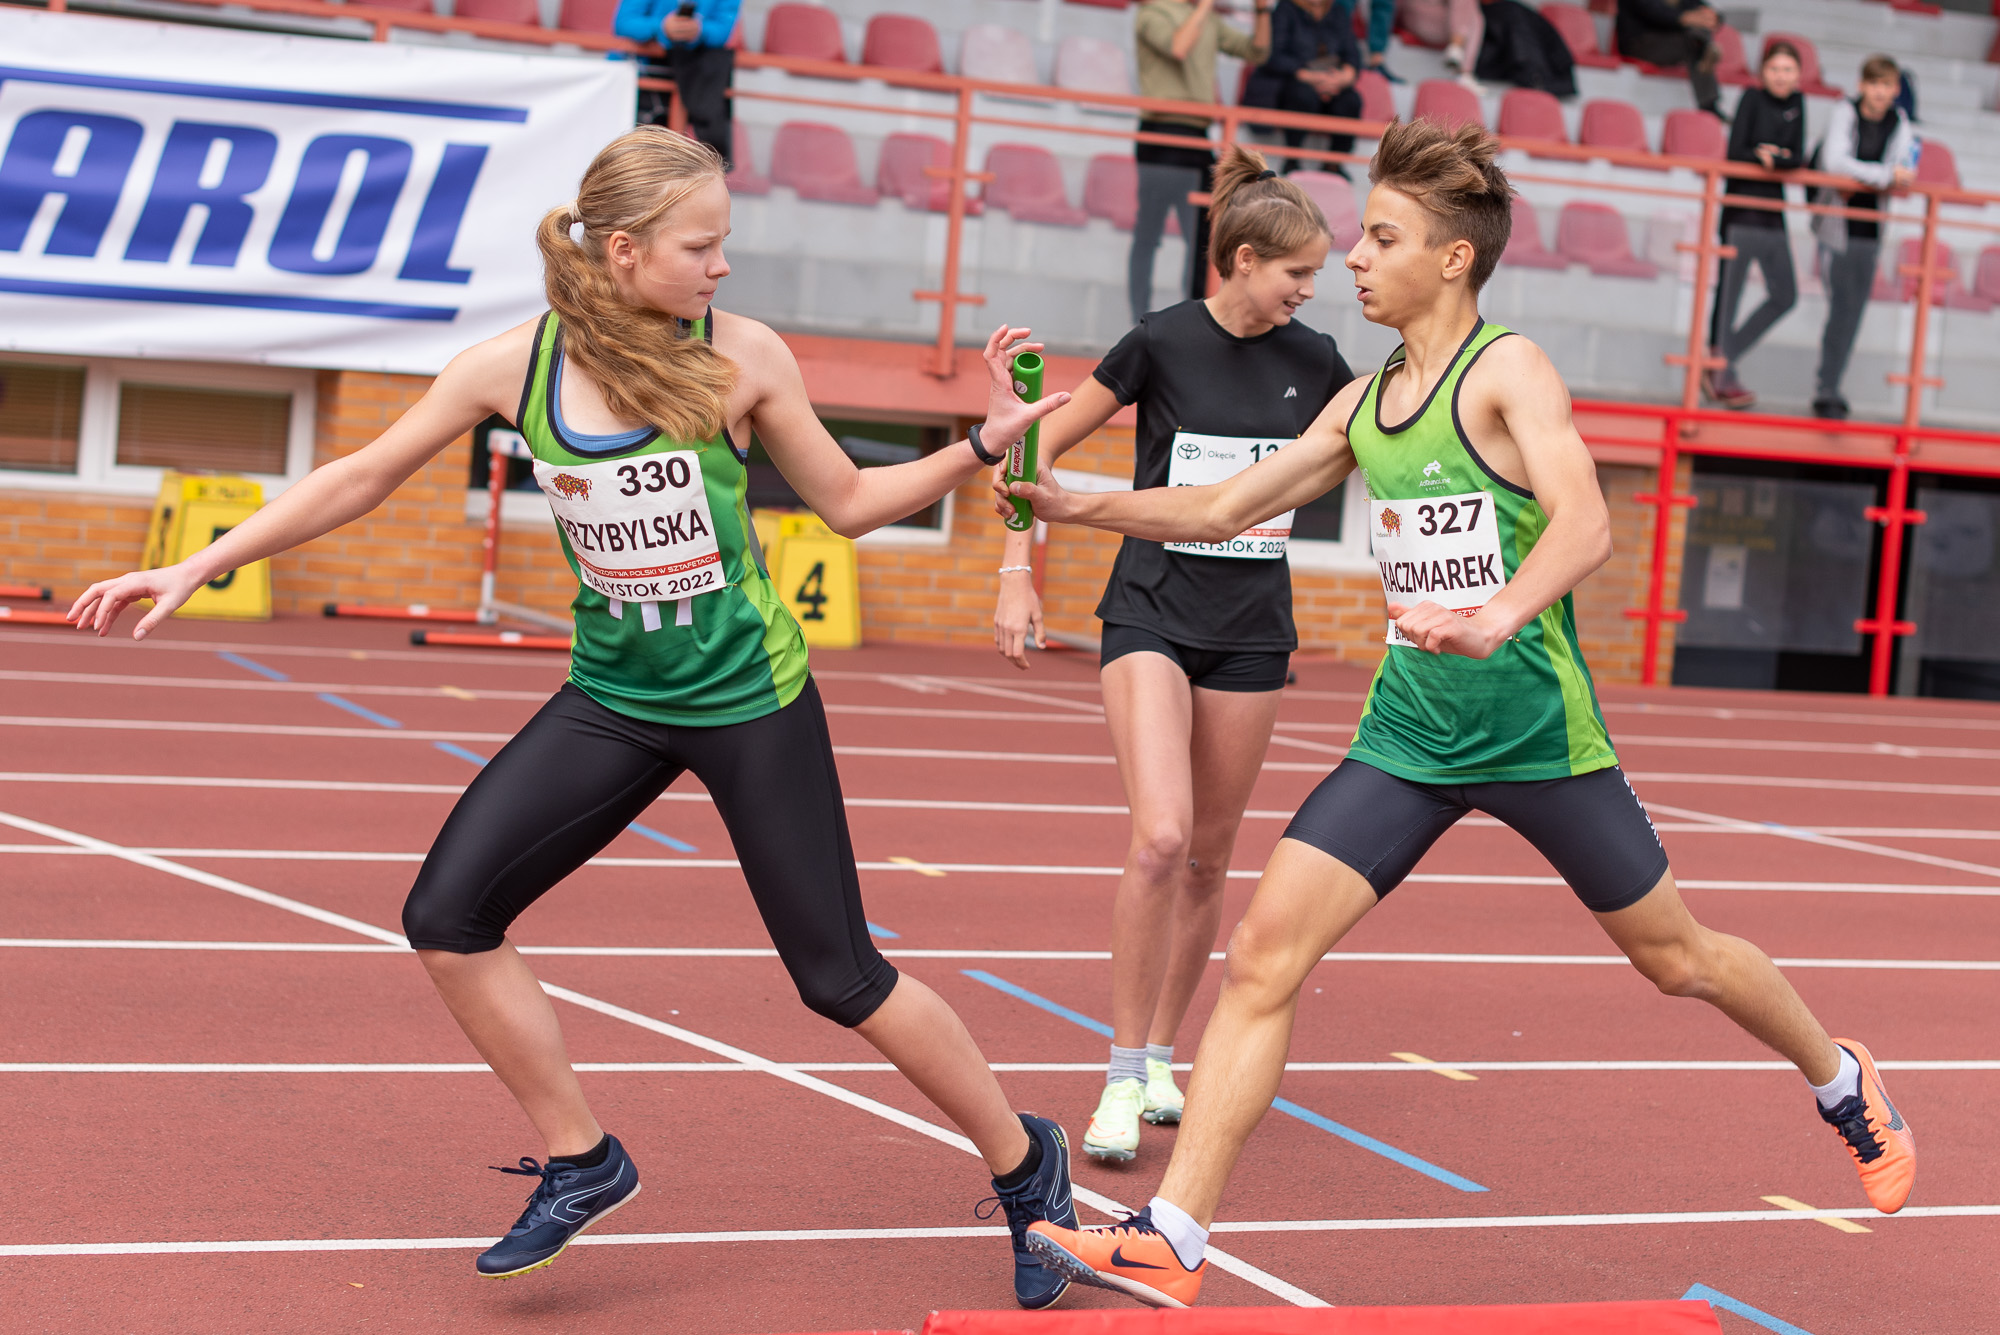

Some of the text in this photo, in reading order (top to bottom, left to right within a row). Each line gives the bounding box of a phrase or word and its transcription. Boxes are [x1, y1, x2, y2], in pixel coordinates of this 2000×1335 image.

[1013, 446, 1022, 475] polanik
[1207, 450, 1237, 460] Okęcie
[617, 456, 691, 497] 330
[557, 509, 709, 552] PRZYBYLSKA
[1417, 498, 1483, 536] 327
[584, 569, 715, 597] BIAŁYSTOK 2022
[629, 569, 658, 577] POLSKI
[667, 554, 717, 574] SZTAFETACH
[1380, 553, 1499, 594] KACZMAREK
[796, 561, 828, 621] 4
